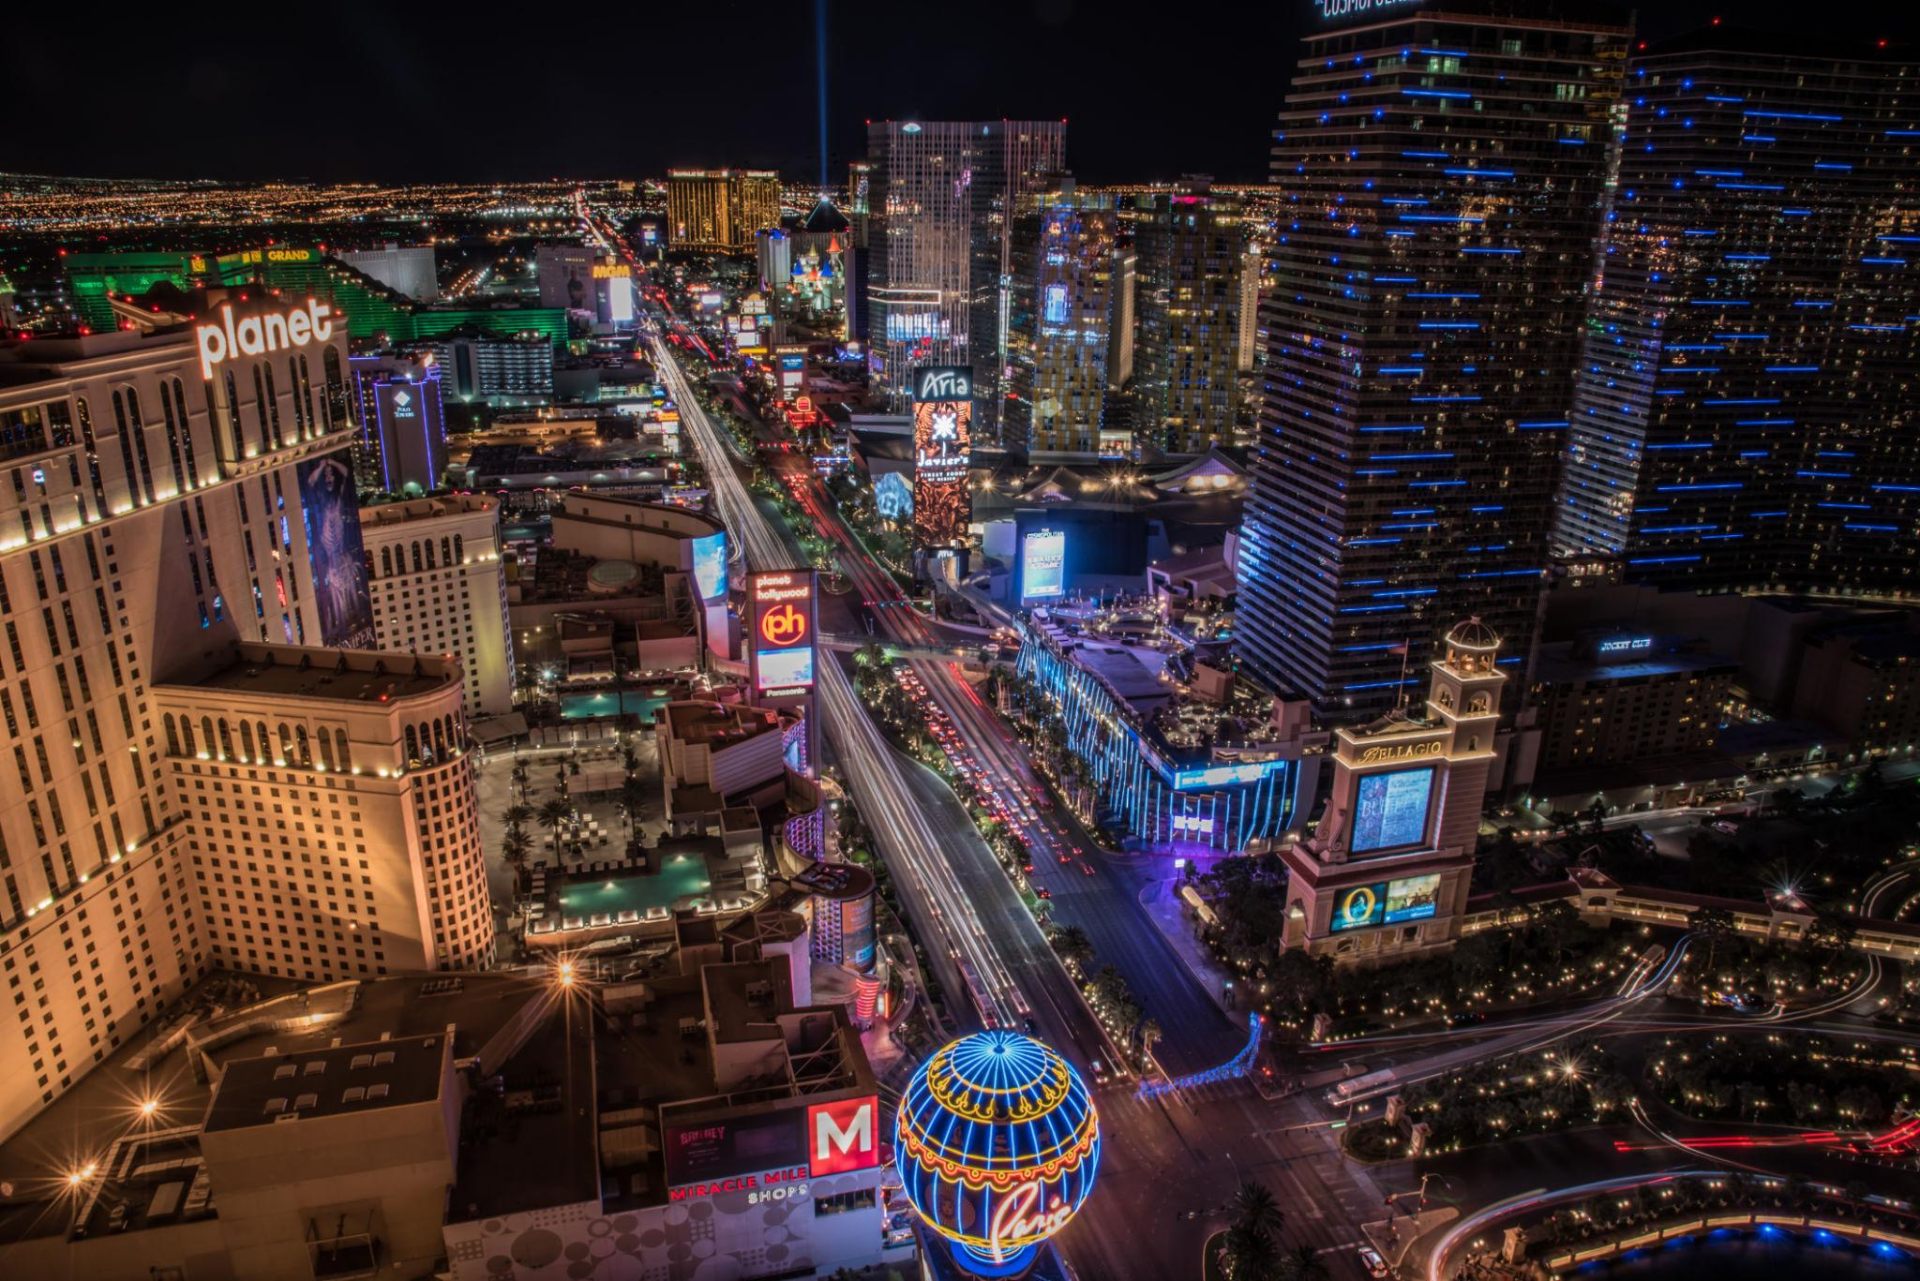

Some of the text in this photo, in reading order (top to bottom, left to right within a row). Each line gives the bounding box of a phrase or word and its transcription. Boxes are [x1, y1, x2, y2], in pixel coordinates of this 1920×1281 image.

[268, 250, 310, 261] GRAND
[593, 265, 630, 278] MGM
[197, 298, 332, 380] planet
[921, 371, 968, 399] Aria
[918, 448, 969, 467] Javier's
[757, 575, 791, 588] planet
[757, 587, 809, 600] hollywood
[767, 604, 806, 641] ph
[766, 687, 806, 697] Panasonic
[1358, 741, 1441, 763] BELLAGIO
[816, 1104, 871, 1160] M
[670, 1166, 808, 1201] MIRACLE MILE
[748, 1184, 808, 1205] SHOPS
[991, 1181, 1071, 1264] Paris
